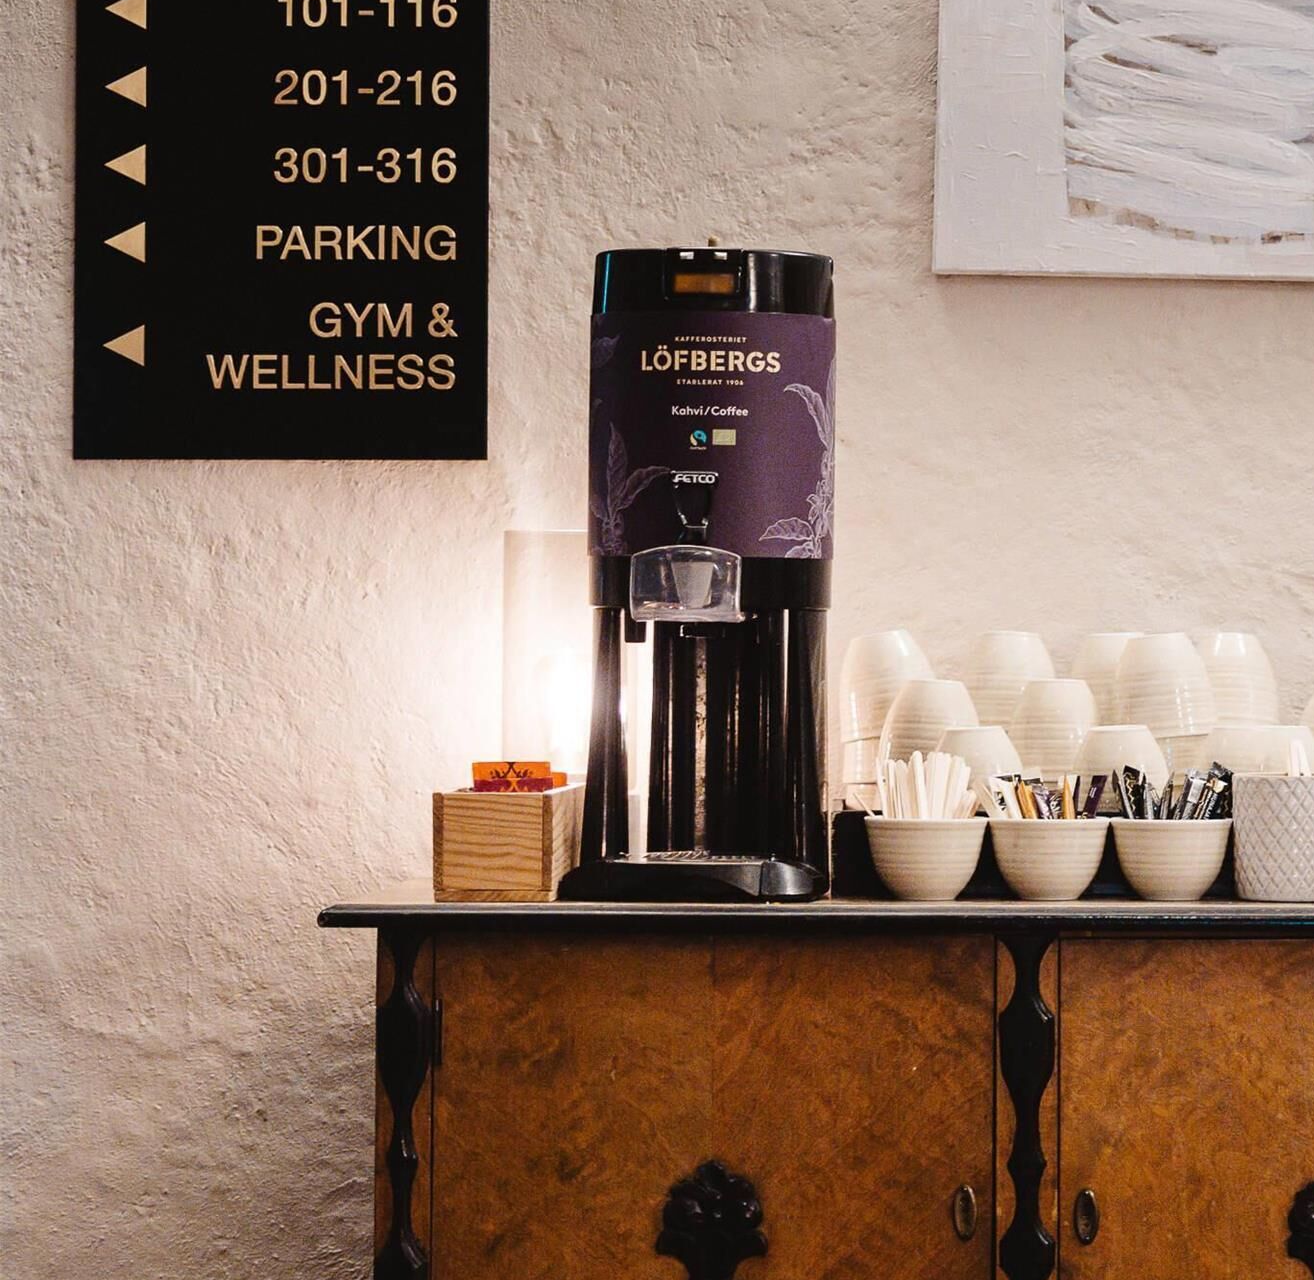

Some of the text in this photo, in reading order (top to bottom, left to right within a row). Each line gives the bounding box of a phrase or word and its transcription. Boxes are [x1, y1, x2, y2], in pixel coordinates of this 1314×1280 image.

[273, 69, 458, 107] 201-216
[273, 147, 458, 185] 301-316
[255, 224, 458, 262] PARKING
[309, 301, 458, 339] GYM &
[206, 353, 457, 391] WELLNESS
[641, 345, 781, 373] LÖFBERGS
[672, 473, 716, 484] FETCO
